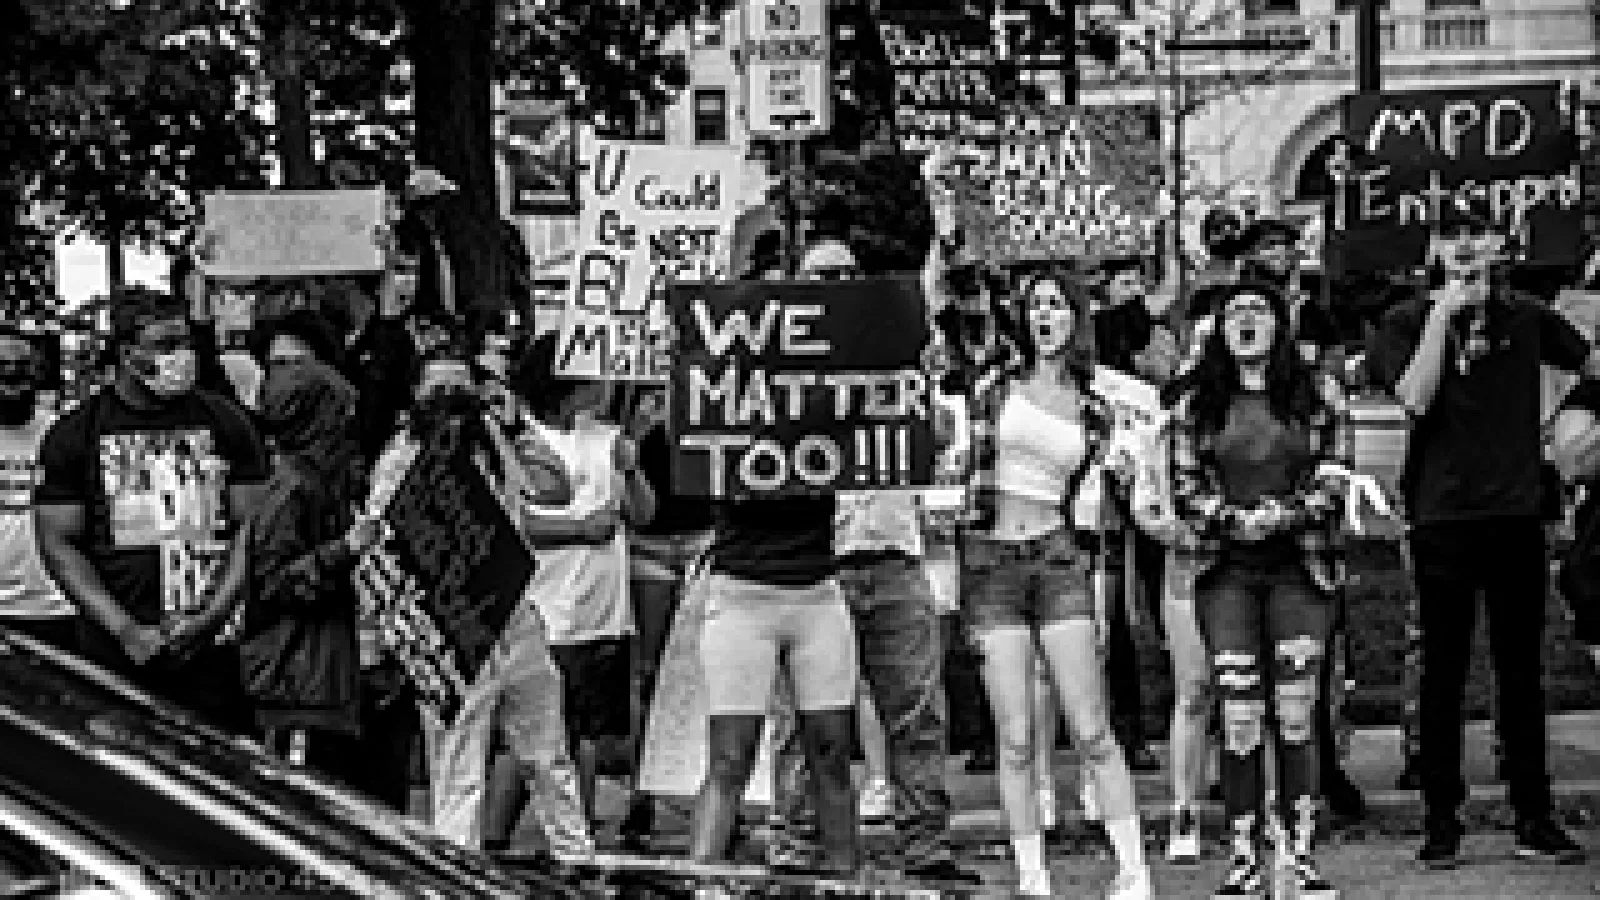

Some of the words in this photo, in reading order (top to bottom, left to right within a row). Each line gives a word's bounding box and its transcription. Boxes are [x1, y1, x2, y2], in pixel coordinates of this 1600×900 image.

[766, 4, 801, 31] NO
[1366, 99, 1532, 159] MPD
[593, 148, 627, 197] U
[634, 171, 722, 211] Could
[990, 179, 1121, 221] BEING
[647, 224, 718, 264] NEXT
[689, 299, 832, 356] WE
[688, 364, 926, 426] MATTER
[679, 425, 911, 498] TOO!!!
